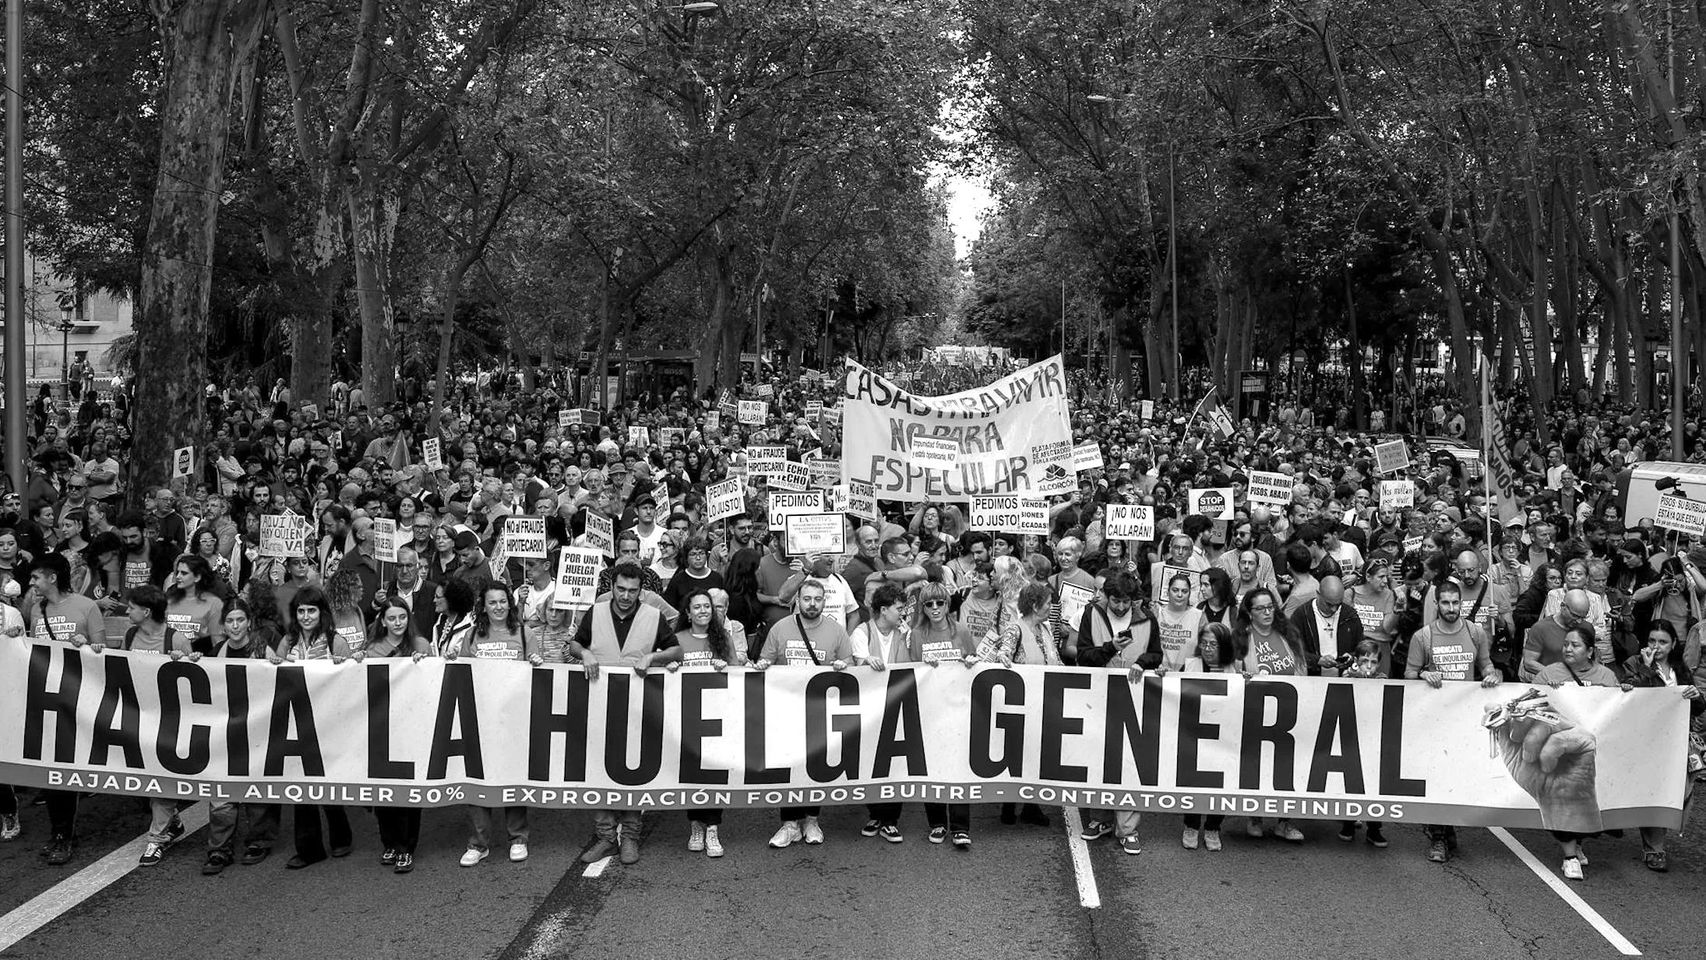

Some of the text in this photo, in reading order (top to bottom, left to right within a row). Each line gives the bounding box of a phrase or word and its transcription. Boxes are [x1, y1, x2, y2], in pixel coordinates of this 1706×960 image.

[845, 366, 932, 416] CASAS
[994, 362, 1063, 409] VIVIR
[890, 418, 1004, 454] NO PARA
[748, 448, 756, 458] NO
[763, 448, 785, 458] FRAUDE
[1032, 440, 1071, 453] PLATAFORMA
[1040, 446, 1071, 458] AFECTADOS
[870, 455, 1031, 496] ESPECULAR
[849, 483, 855, 493] NO
[860, 484, 874, 497] FRAUDE
[1039, 479, 1077, 491] ALCORCÓN
[772, 495, 819, 510] ¡PEDIMOS
[835, 489, 846, 503] Nos
[1200, 496, 1223, 505] STOP
[972, 497, 1018, 512] ¡PEDIMOS
[1200, 505, 1225, 513] DESAHUCIOS
[1677, 499, 1685, 509] SU
[708, 504, 716, 518] LO
[1111, 507, 1147, 521] ¡NO NOS
[289, 516, 304, 529] NO
[770, 513, 784, 526] LO
[971, 514, 1020, 528] LO JUSTO!
[1676, 512, 1685, 522] QUE
[1685, 514, 1705, 526] ESTALLA
[506, 520, 544, 533] NO al FRAUDE
[597, 518, 611, 535] FRAUDE
[1107, 523, 1152, 538] CALLARÁN!
[274, 528, 303, 539] QUIEN
[564, 553, 599, 565] POR UNA
[565, 564, 595, 576] HUELGA
[562, 575, 594, 587] GENERAL
[571, 587, 581, 597] YA
[1432, 645, 1463, 654] SINDICATO
[1441, 653, 1473, 662] INQUILINAS
[23, 645, 1426, 797] HACIA LA HUELGA GENERAL
[48, 770, 163, 794] BAJADA
[176, 781, 230, 798] DEL
[244, 784, 394, 804] ALQUILER
[408, 785, 465, 803] 50%
[502, 788, 732, 806] EXPROPIACIÓN
[747, 785, 866, 804] FONDOS
[880, 784, 983, 800] BUITRE
[1018, 785, 1195, 809] CONTRATOS
[1209, 796, 1405, 819] INDEFINIDOS
